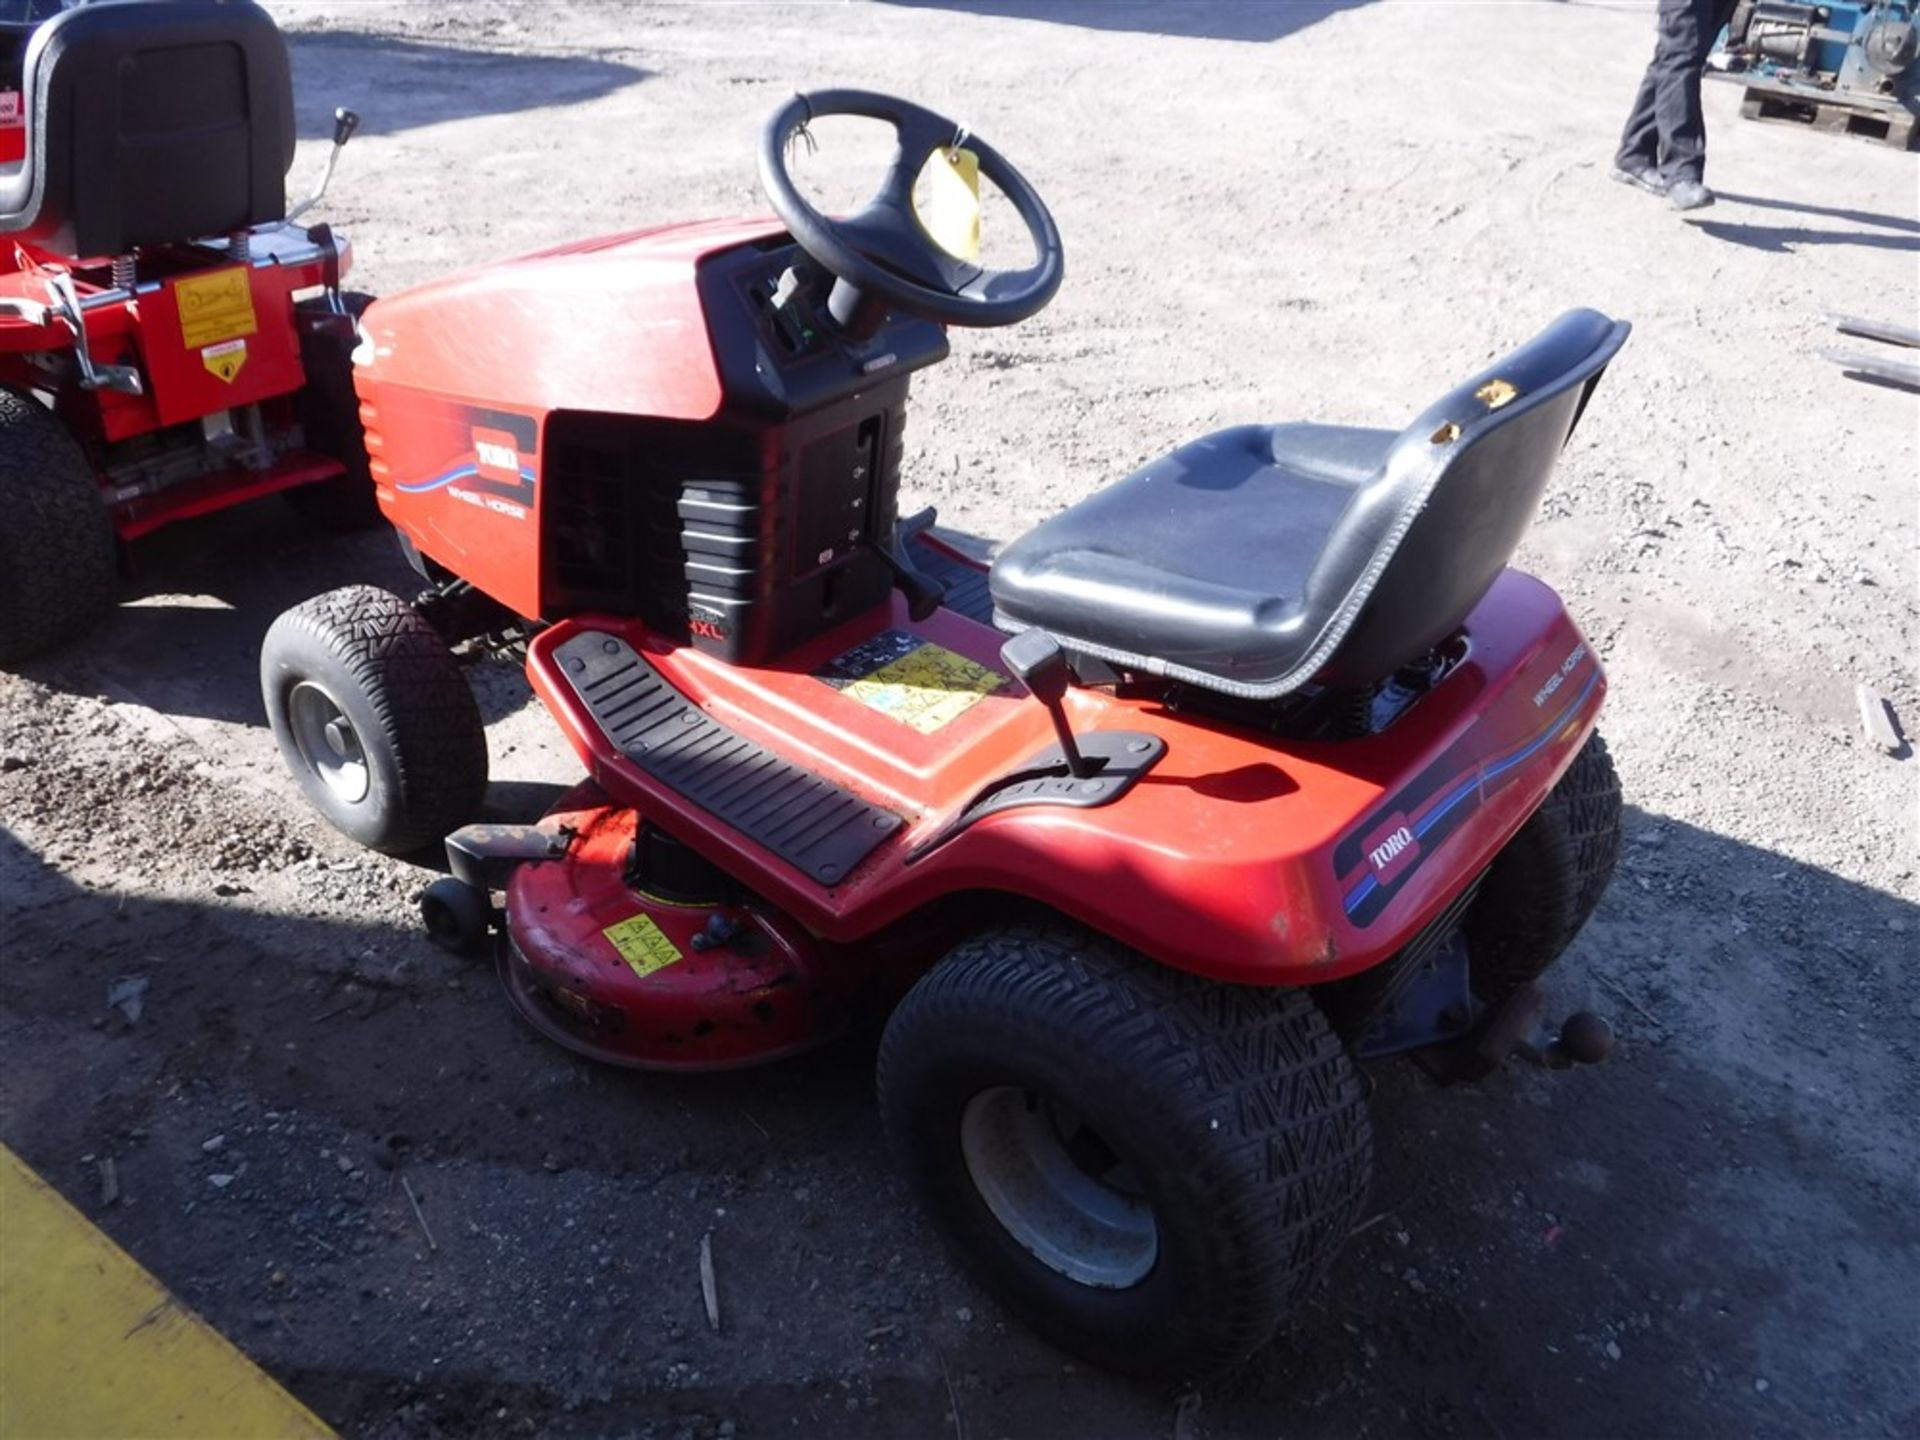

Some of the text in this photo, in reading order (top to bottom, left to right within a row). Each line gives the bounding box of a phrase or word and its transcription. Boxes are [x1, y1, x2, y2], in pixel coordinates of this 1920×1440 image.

[475, 440, 519, 471] TORO
[485, 496, 526, 519] HORSE
[1533, 643, 1586, 707] WHEEL HORSE
[1368, 827, 1413, 869] TORO
